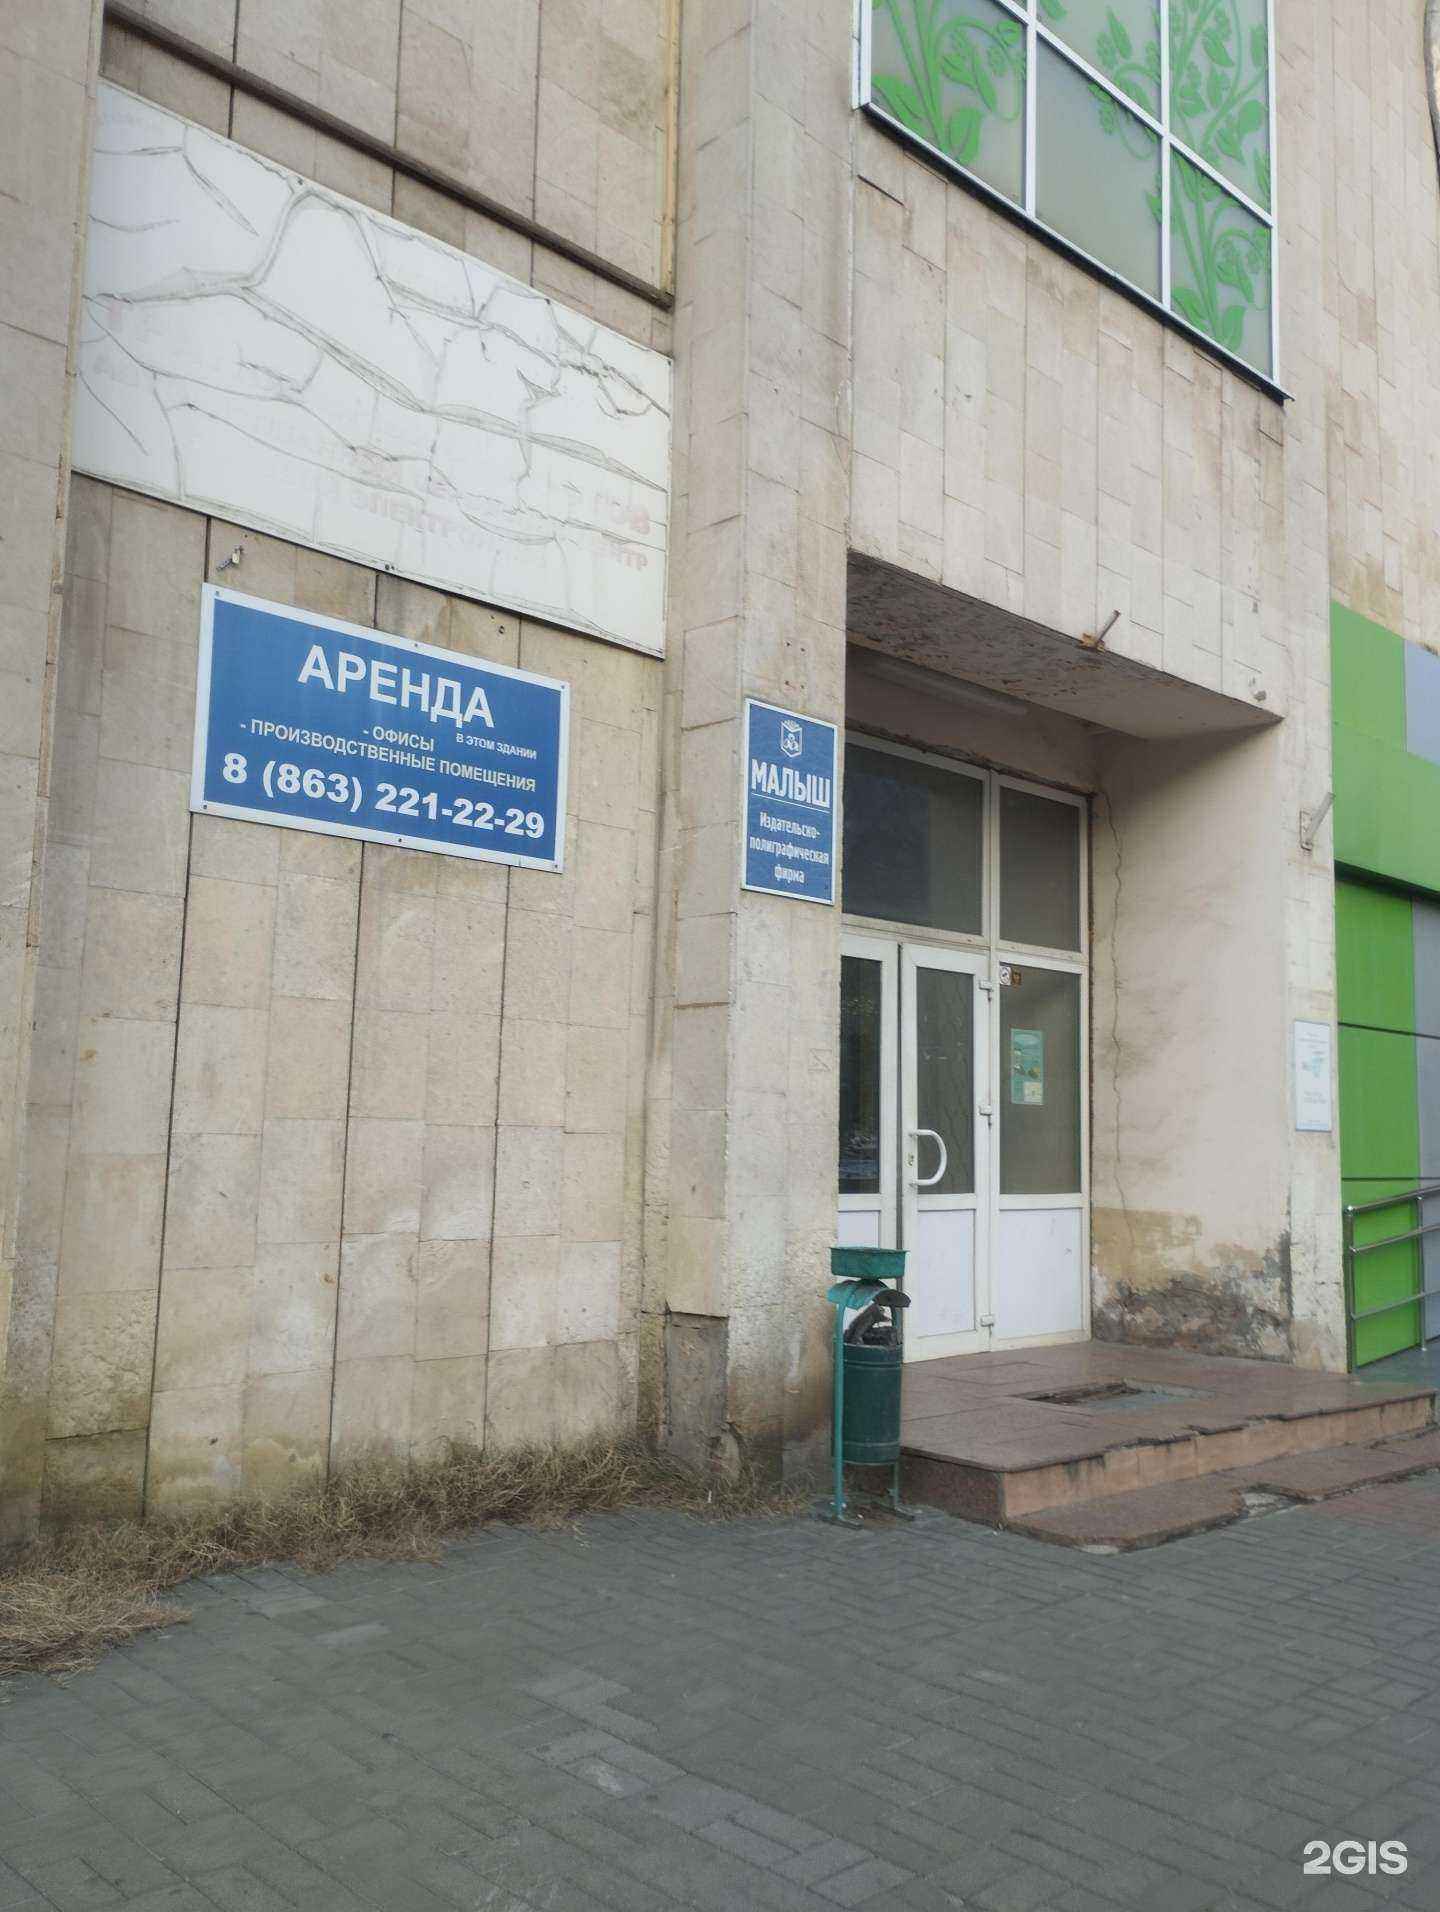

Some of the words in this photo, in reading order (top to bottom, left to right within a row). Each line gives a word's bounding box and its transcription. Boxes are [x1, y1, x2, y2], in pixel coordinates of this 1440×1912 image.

[297, 644, 495, 729] АРЕНДА
[372, 726, 435, 752] ОФИСЫ
[456, 732, 464, 744] В
[466, 735, 495, 752] ЭТОМ
[496, 742, 537, 761] ЗДАНИИ
[251, 718, 436, 772] ПРОИЗВОДСТВЕННЫЕ
[440, 760, 537, 793] ПОМЕЩЕНИЯ
[222, 752, 248, 785] 8
[262, 760, 363, 813] (863)
[374, 783, 546, 839] 221-22-29
[751, 759, 831, 809] МАЛЫШ
[759, 812, 821, 839] Издательско-
[749, 836, 830, 865] полиграфическая
[774, 863, 805, 884] фирма
